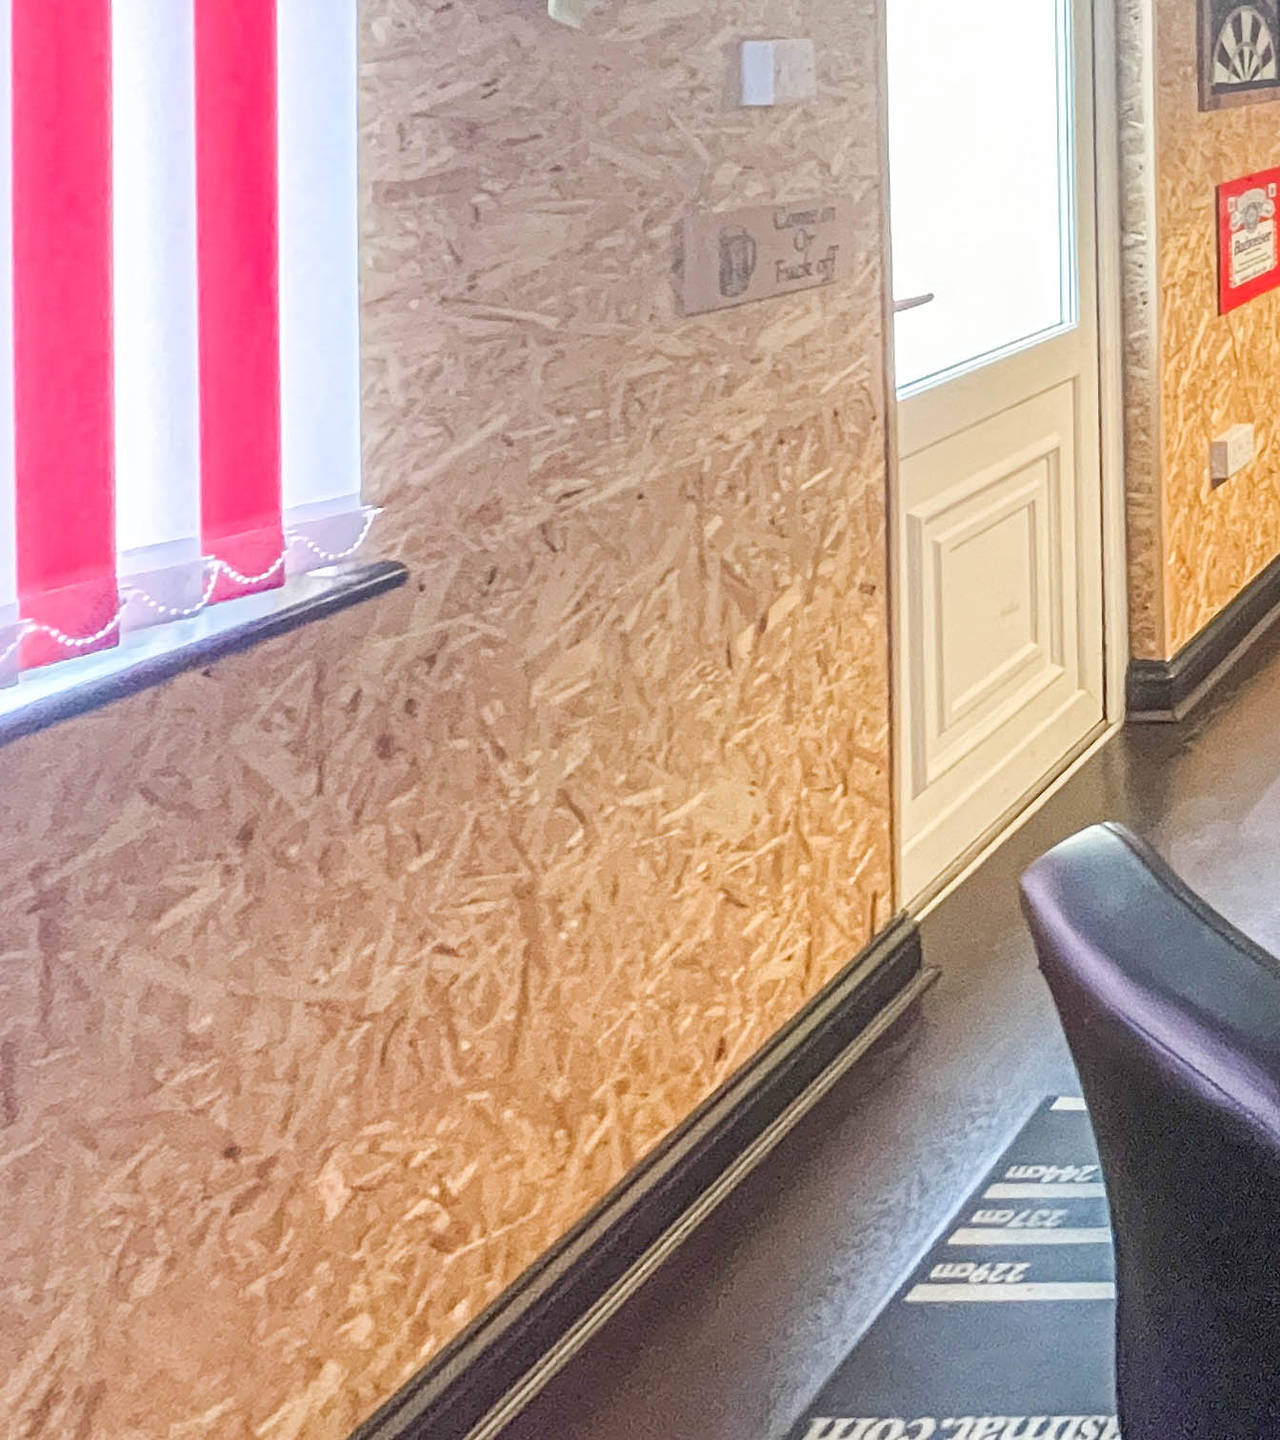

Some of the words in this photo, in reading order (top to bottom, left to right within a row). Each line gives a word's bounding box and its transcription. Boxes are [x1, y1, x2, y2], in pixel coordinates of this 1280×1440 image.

[1003, 1164, 1100, 1184] 244cm
[970, 1209, 1069, 1228] 237cm
[928, 1262, 1032, 1284] 229cm
